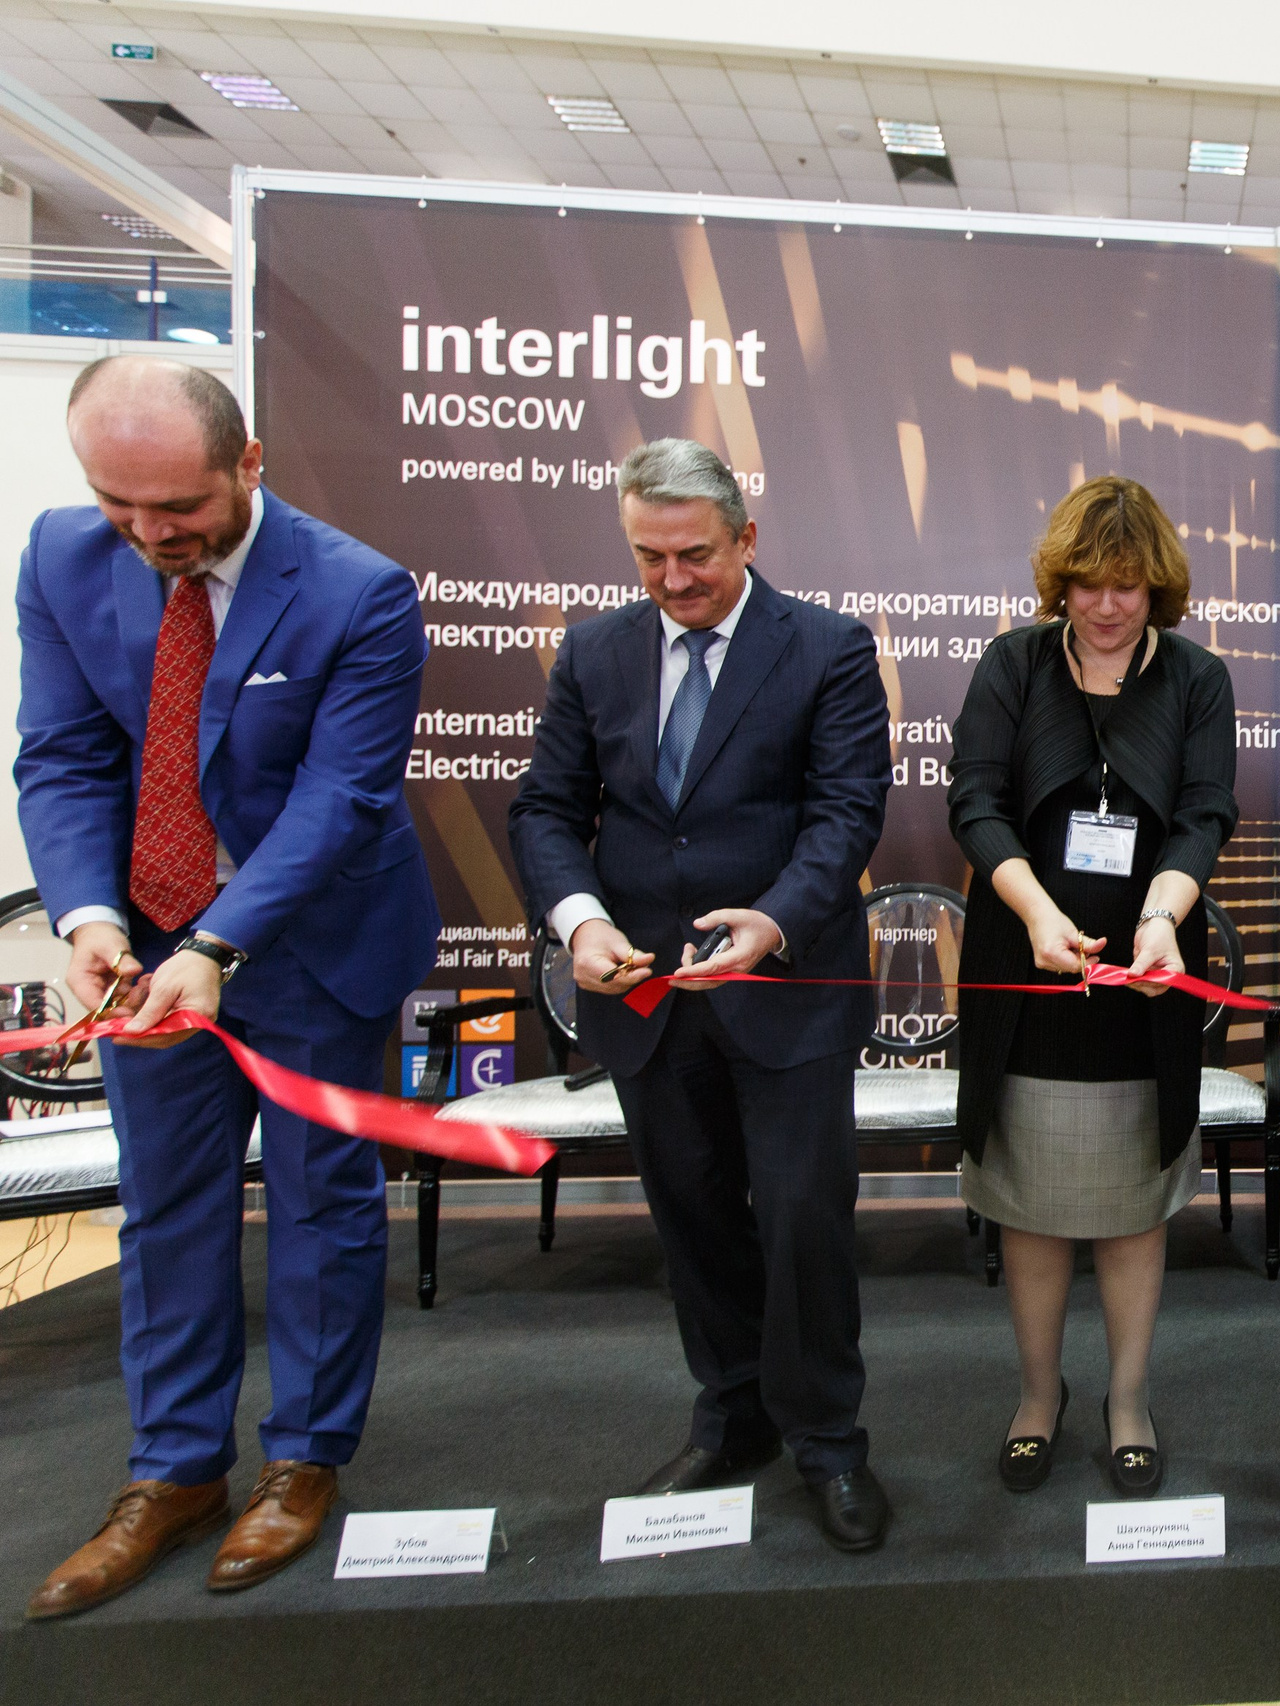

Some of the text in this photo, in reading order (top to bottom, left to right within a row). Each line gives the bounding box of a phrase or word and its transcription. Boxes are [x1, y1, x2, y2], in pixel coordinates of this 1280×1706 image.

[402, 306, 766, 398] interlight
[402, 392, 586, 431] MOSCOW
[402, 457, 523, 483] powered
[531, 457, 565, 489] by
[572, 459, 619, 490] ligh
[838, 591, 1044, 621] декоративно
[424, 623, 566, 654] лектроте
[414, 707, 541, 737] nternati
[438, 923, 526, 943] циальный
[874, 928, 937, 945] партнер
[463, 948, 494, 967] Fair
[497, 948, 531, 967] Part
[625, 1526, 728, 1545] Михаил Иванович
[1107, 1541, 1134, 1551] Анна
[342, 1552, 485, 1569] Дмитрий Александрович
